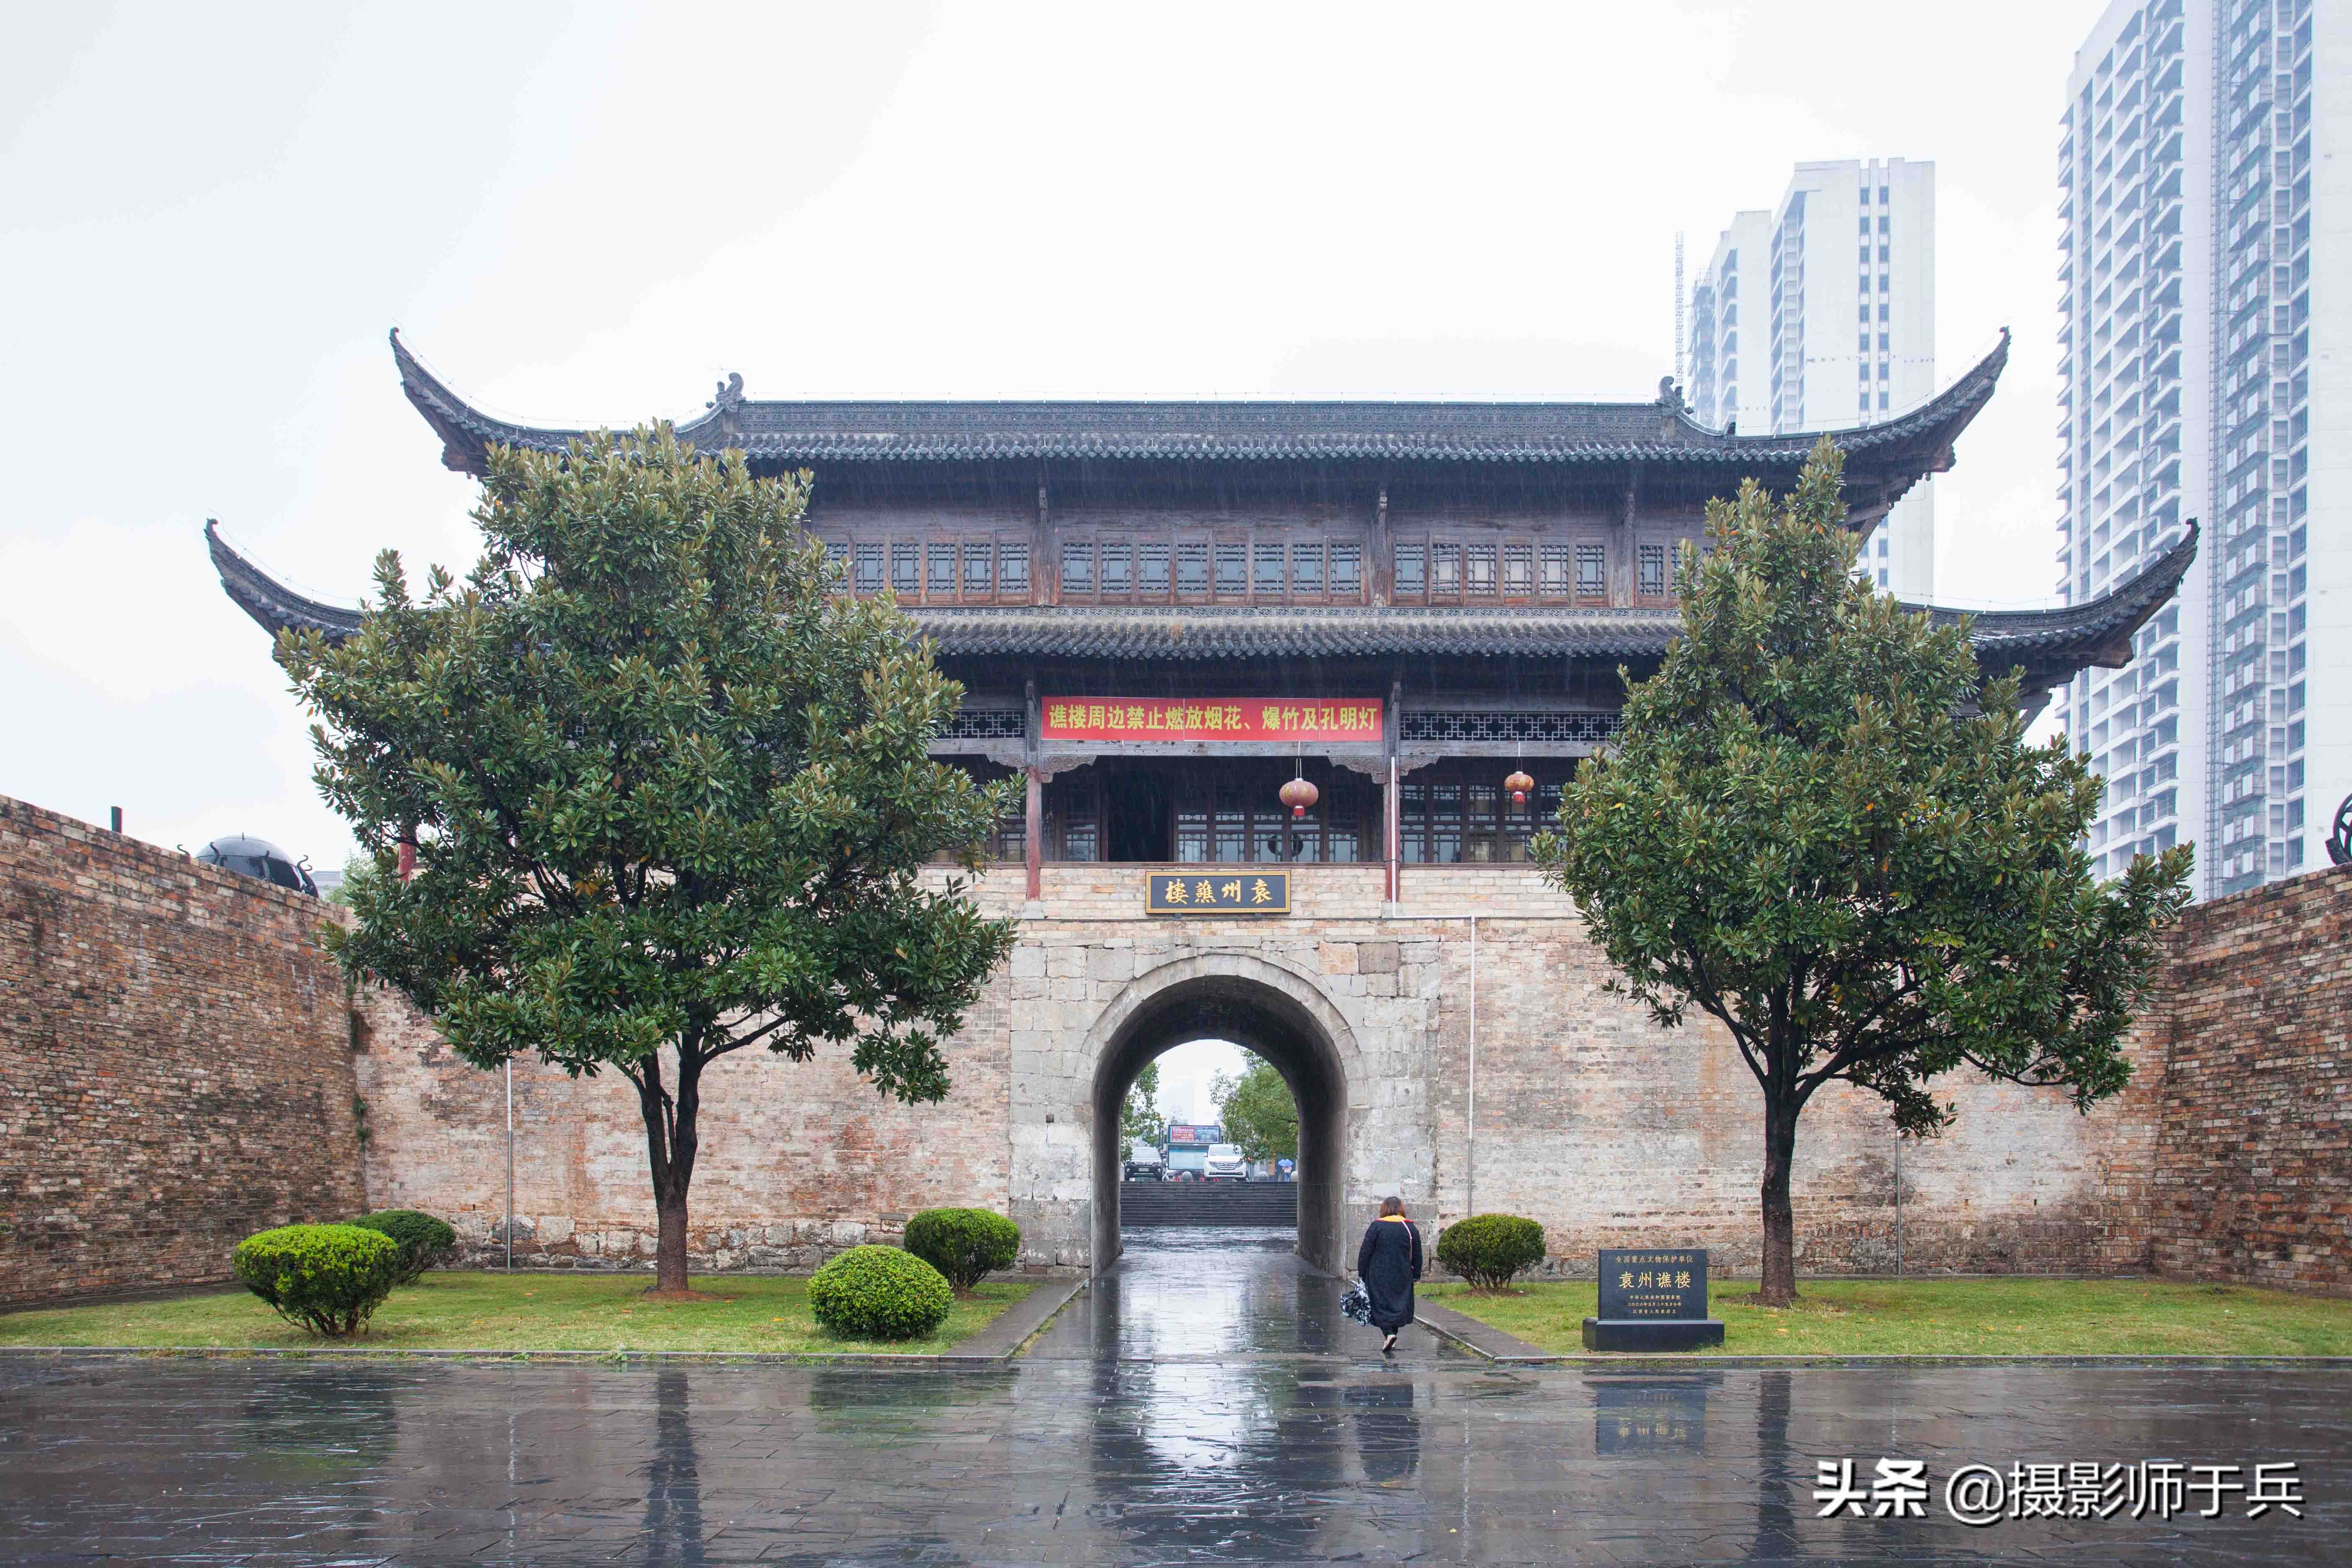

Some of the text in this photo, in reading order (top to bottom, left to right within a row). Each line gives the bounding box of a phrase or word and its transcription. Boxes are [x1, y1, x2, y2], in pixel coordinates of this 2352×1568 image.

[1049, 704, 1377, 731] 谯楼周边禁止燃放烟花、爆竹及孔明灯
[1619, 1271, 1691, 1288] 袁州谯楼
